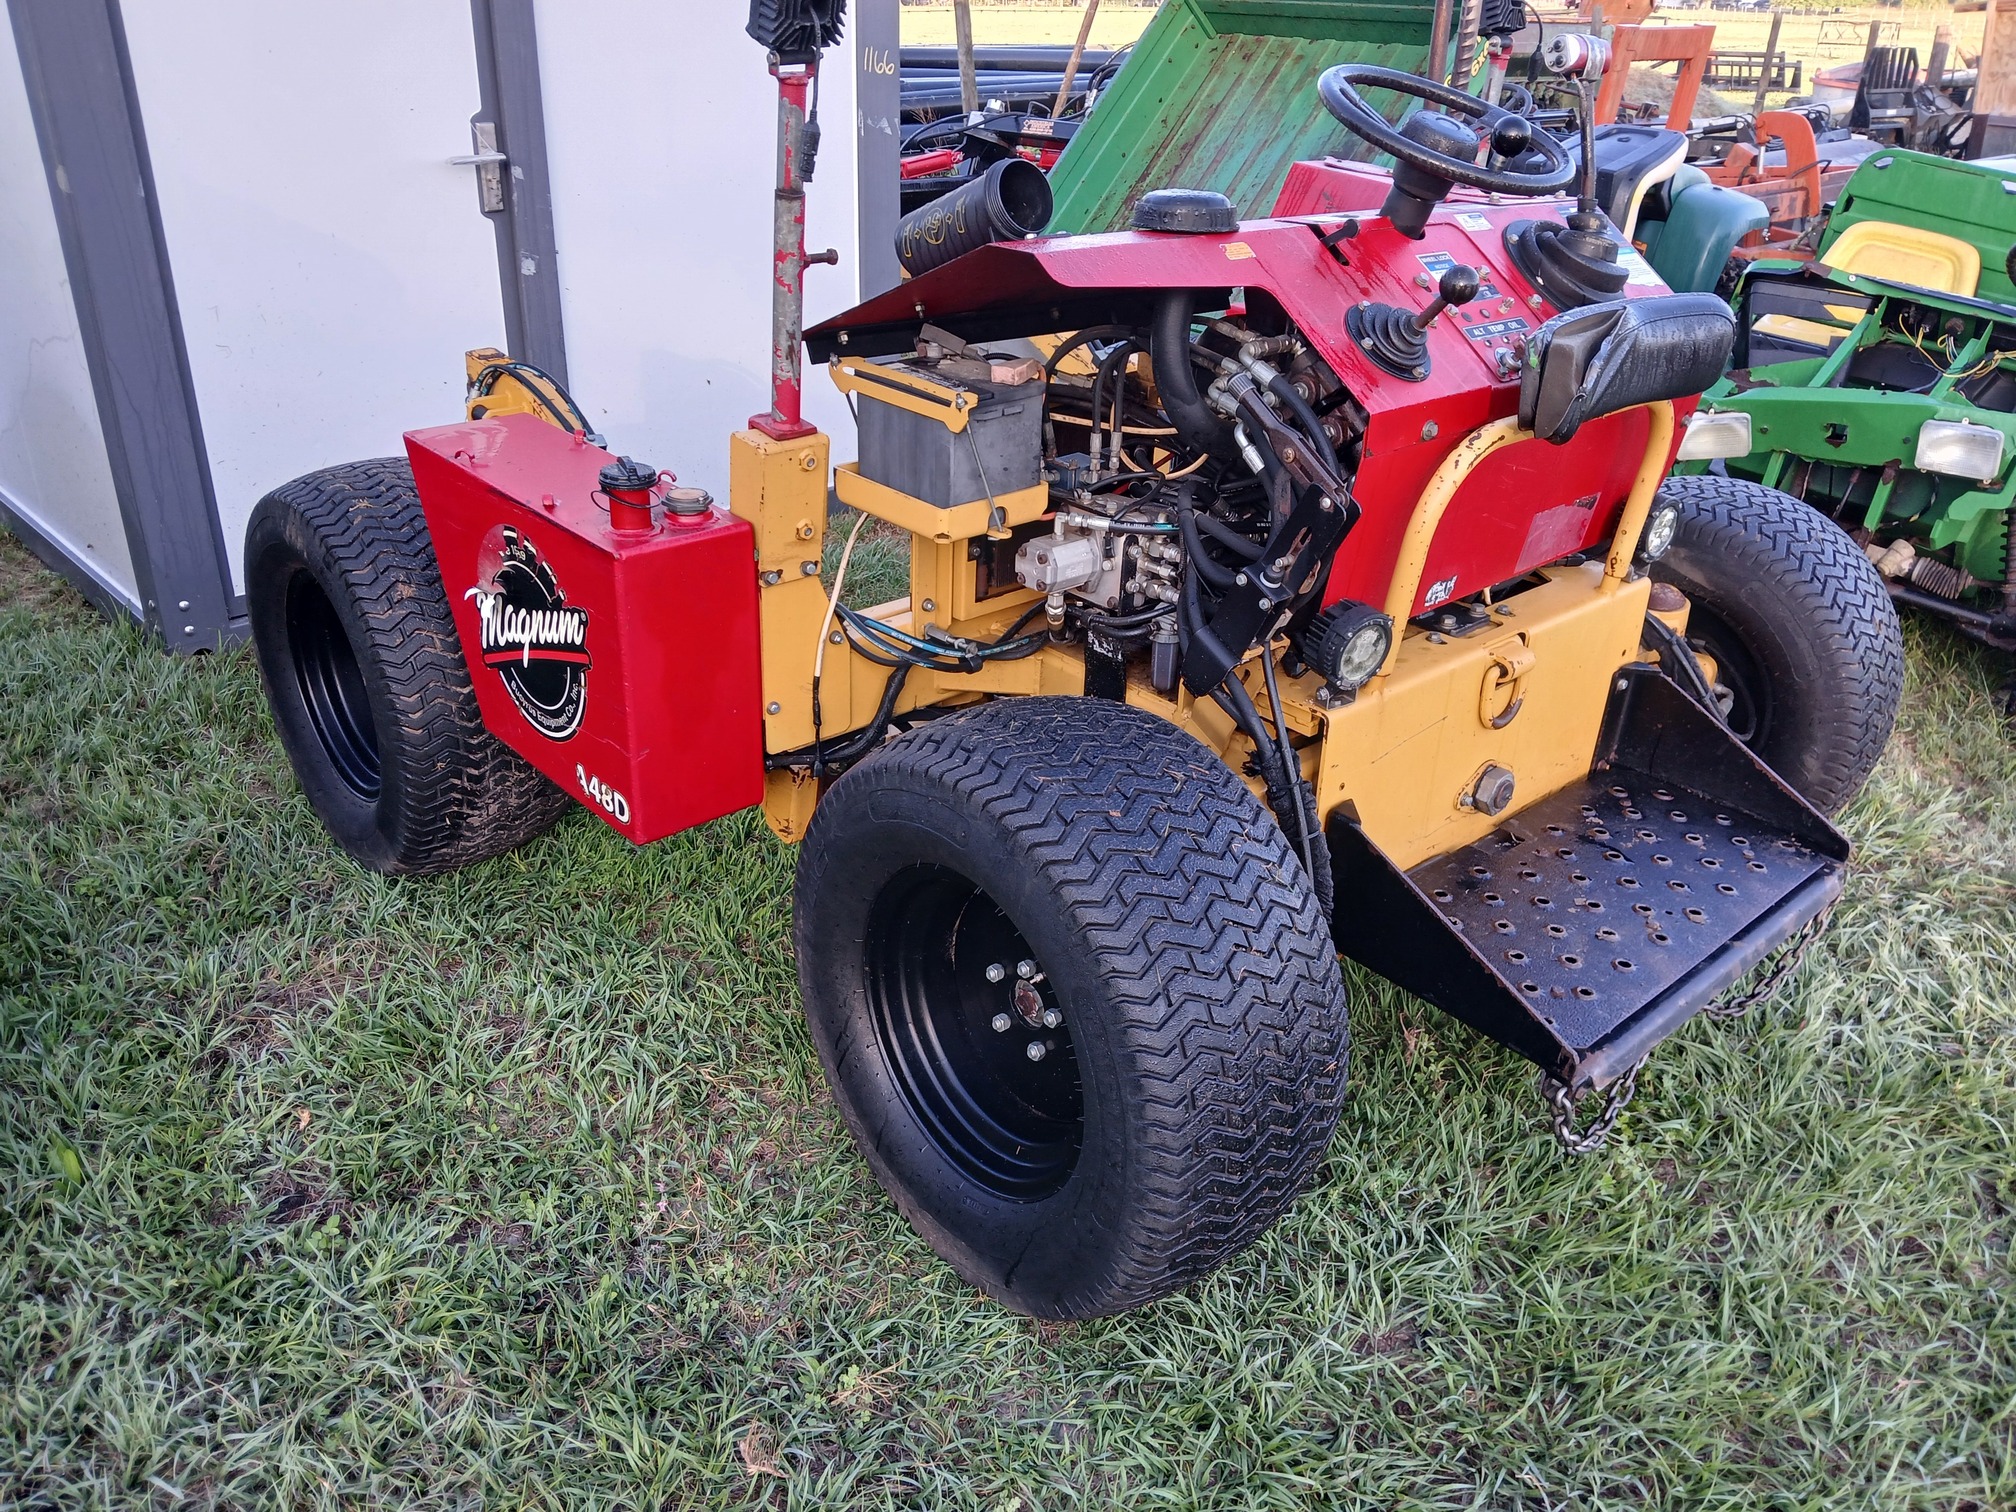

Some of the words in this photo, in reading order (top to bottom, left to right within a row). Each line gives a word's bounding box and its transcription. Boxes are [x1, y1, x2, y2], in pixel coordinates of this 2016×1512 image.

[864, 46, 895, 75] 1166
[1472, 327, 1486, 336] ALT
[1487, 323, 1505, 333] TEMP
[1507, 321, 1521, 330] OIL
[477, 592, 585, 668] Magnum
[511, 680, 537, 717] Bucyrus
[537, 710, 569, 730] Equipment
[576, 763, 631, 824] A48D
